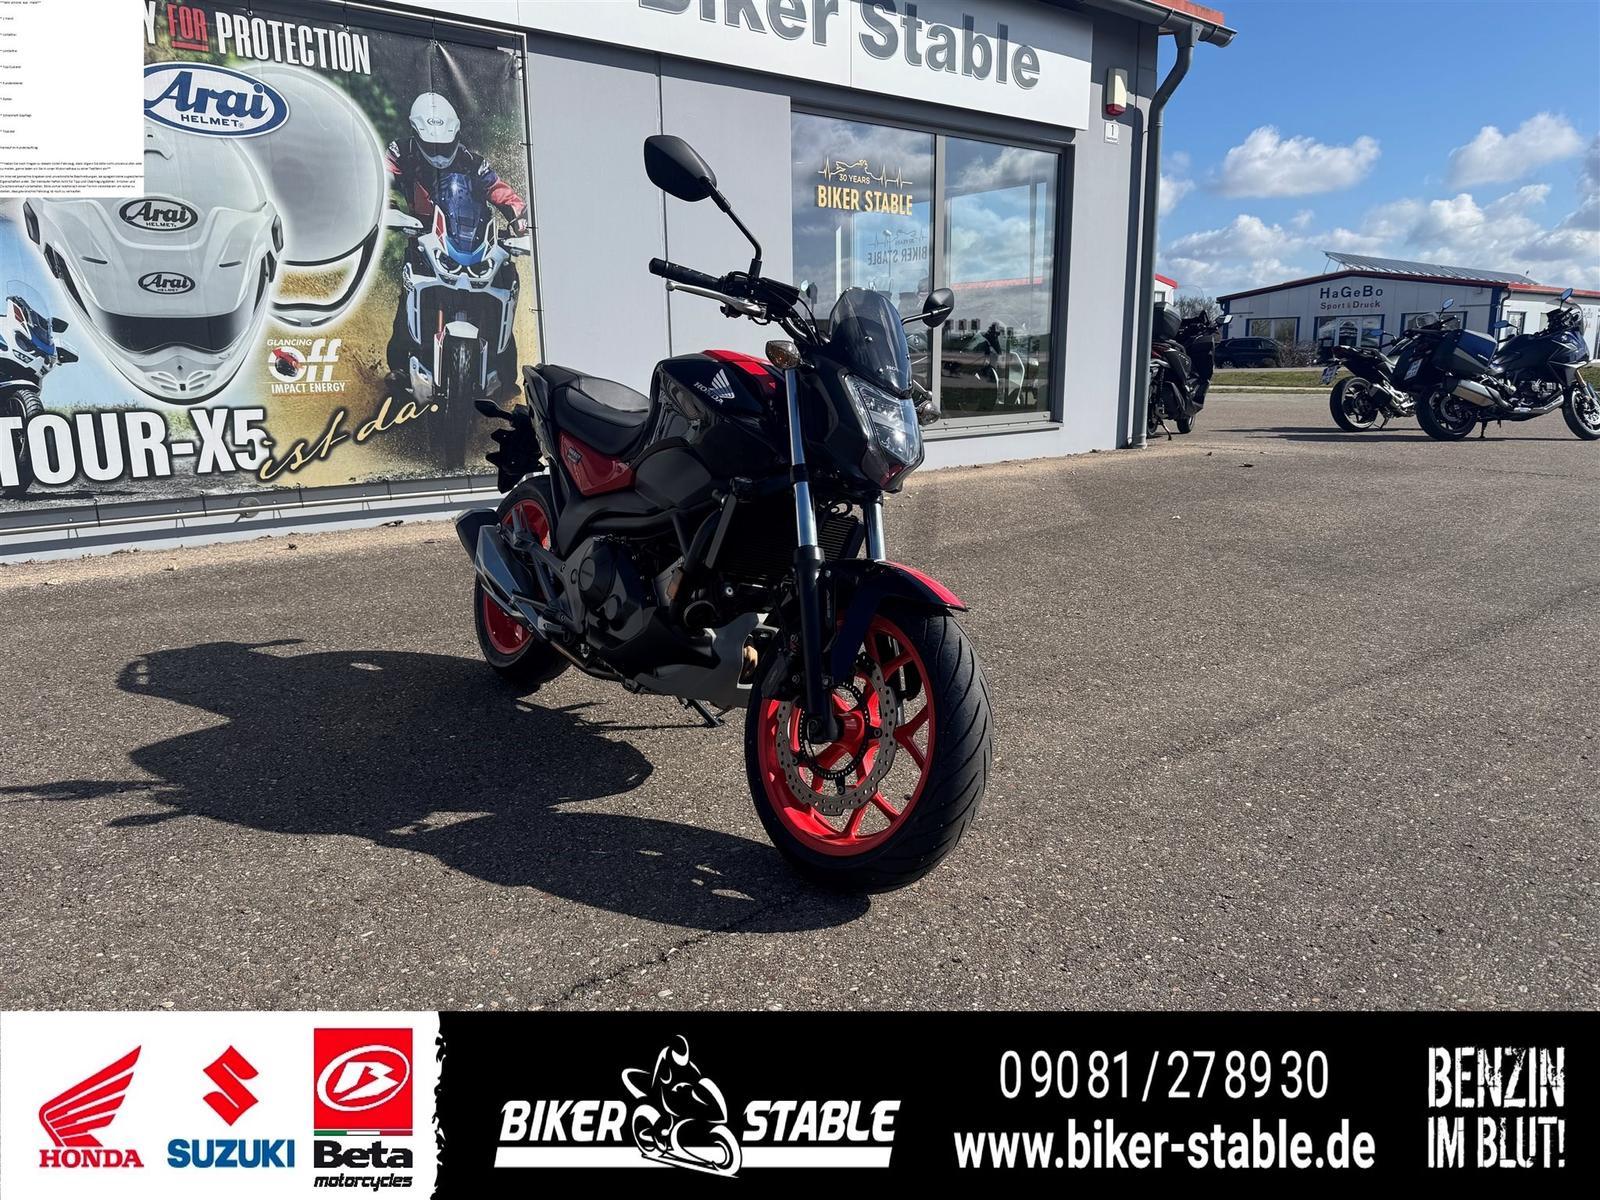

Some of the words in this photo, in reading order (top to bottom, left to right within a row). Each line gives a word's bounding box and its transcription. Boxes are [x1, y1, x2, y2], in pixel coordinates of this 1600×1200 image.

[167, 3, 209, 42] FOR
[215, 11, 371, 75] PROTECTION
[639, 0, 839, 47] ker
[859, 0, 1041, 90] Stable
[144, 71, 268, 119] Arai
[181, 114, 239, 127] HELMET
[848, 174, 871, 185] YEARS
[818, 185, 860, 211] BIKER
[865, 190, 913, 216] STABLE
[127, 202, 189, 223] Arai
[144, 274, 189, 288] Arai
[1320, 285, 1383, 299] HaGeBo
[1352, 300, 1381, 309] Druck
[266, 338, 313, 346] GLANCING
[271, 383, 306, 394] IMPACT
[309, 382, 346, 393] ENERGY
[0, 408, 266, 488] TOUR-X5
[260, 411, 347, 480] ist
